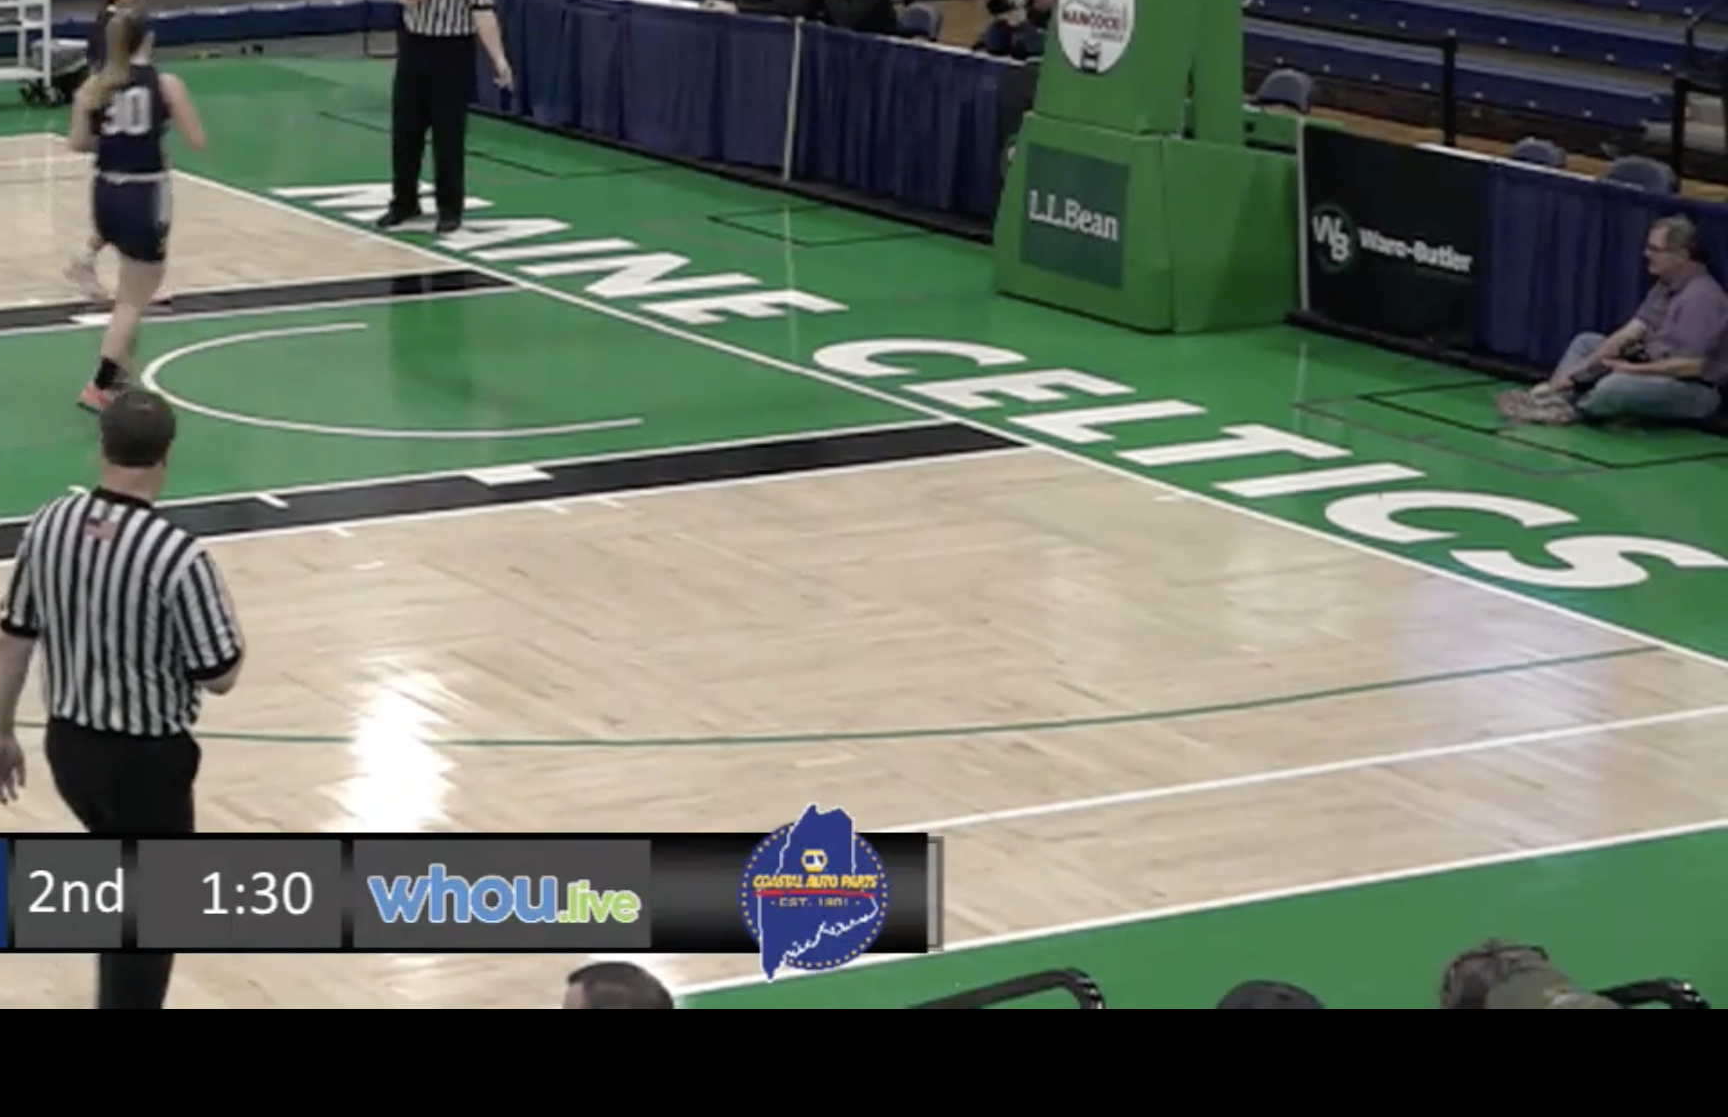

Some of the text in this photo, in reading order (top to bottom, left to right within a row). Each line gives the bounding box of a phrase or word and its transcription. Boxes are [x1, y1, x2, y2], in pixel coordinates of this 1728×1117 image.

[272, 181, 850, 325] MAINE
[1030, 190, 1118, 241] L.L.Bean
[1357, 228, 1473, 272] Ware-Butler
[812, 338, 1728, 589] CELTICS
